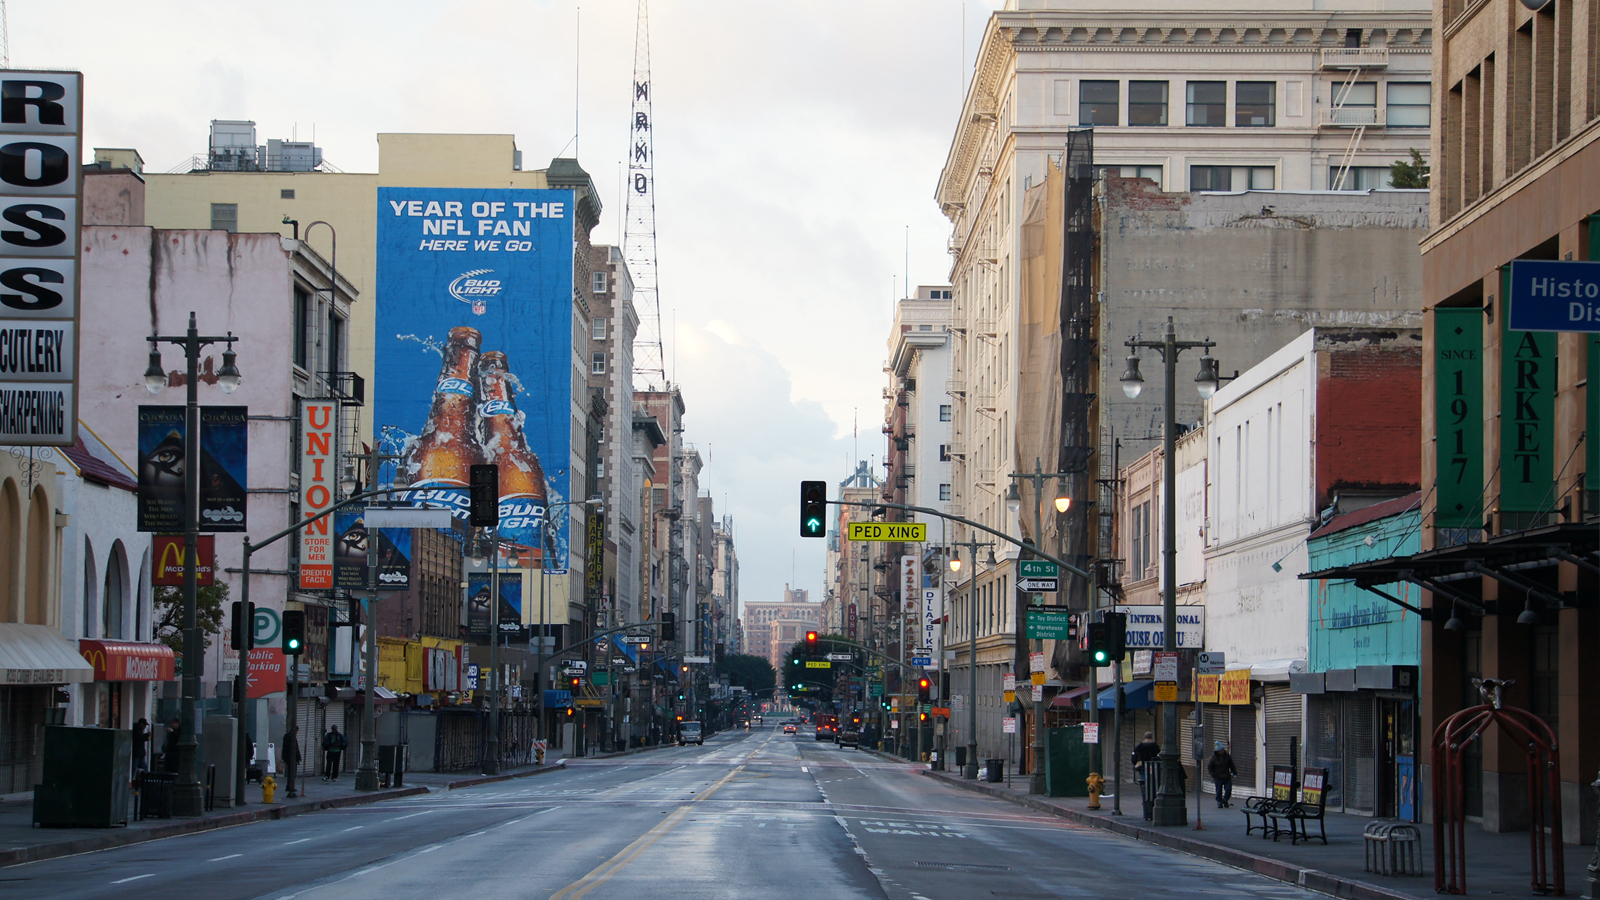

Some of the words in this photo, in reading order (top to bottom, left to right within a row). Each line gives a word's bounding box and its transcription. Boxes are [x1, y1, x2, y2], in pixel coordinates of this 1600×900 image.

[1, 80, 69, 311] ROSS
[389, 200, 463, 217] YEAR
[471, 201, 506, 218] OF
[512, 202, 564, 218] THE
[423, 219, 471, 236] NFL
[478, 220, 531, 236] FAN
[419, 239, 469, 251] HERE
[474, 240, 501, 252] WE
[464, 279, 500, 287] BUD
[455, 286, 502, 295] LIGHT
[0, 329, 64, 374] CUTLERY
[1441, 350, 1476, 361] SINCE
[1513, 331, 1542, 484] ARKET
[1450, 369, 1468, 485] 1917
[305, 406, 332, 536] UNION
[498, 503, 546, 517] BUD
[854, 526, 882, 538] PED
[888, 526, 920, 538] XING
[304, 538, 330, 546] STORE
[301, 569, 332, 577] CREDITO
[1024, 564, 1041, 572] 4th
[306, 576, 327, 584] FACIL
[1130, 614, 1200, 624] INTERNONAL
[1126, 631, 1150, 646] OUSE
[247, 650, 274, 660] Public
[126, 656, 159, 678] McDonald's
[246, 662, 280, 672] Parking
